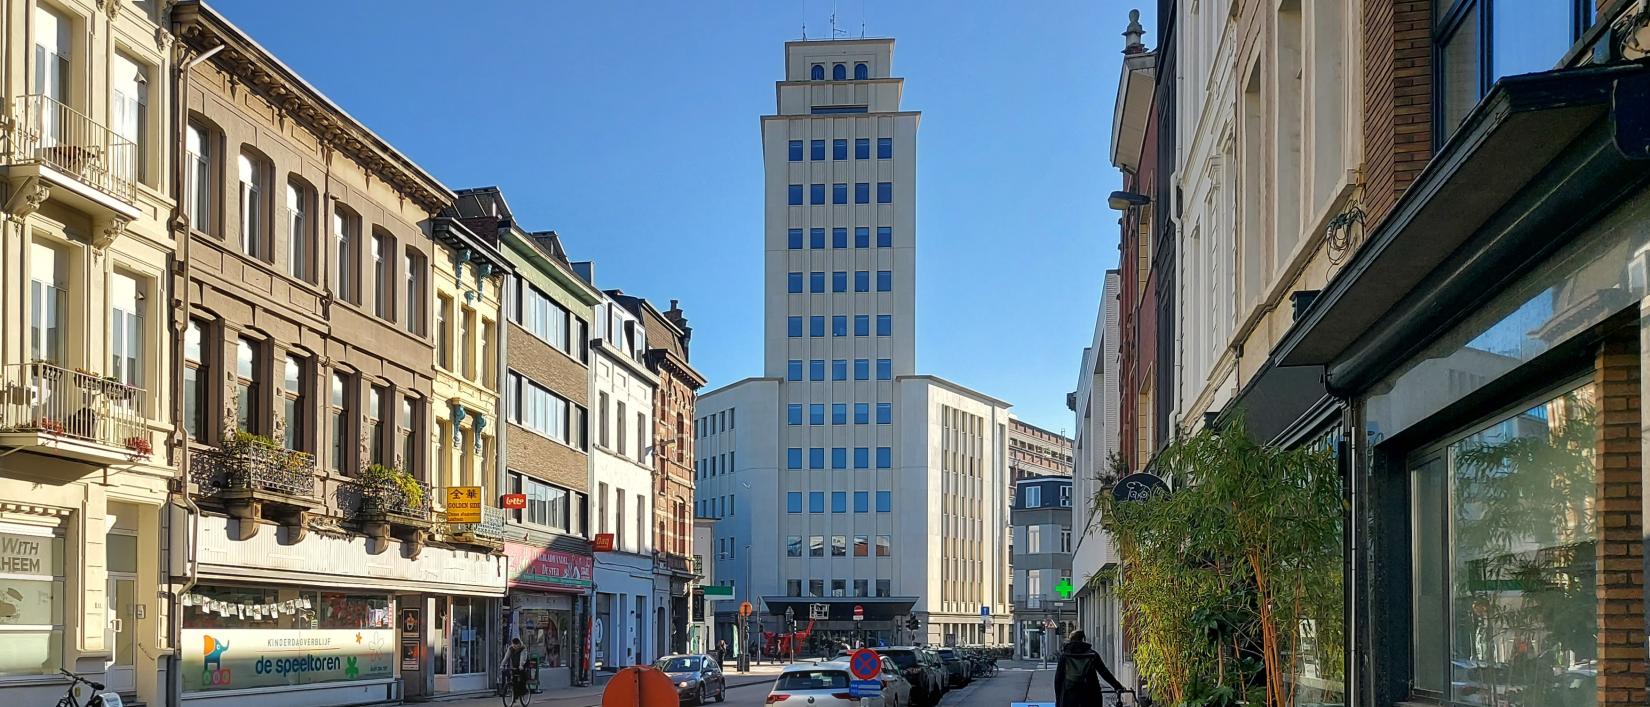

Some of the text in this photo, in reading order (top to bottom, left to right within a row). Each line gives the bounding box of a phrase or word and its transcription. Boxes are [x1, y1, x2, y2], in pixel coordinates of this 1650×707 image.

[267, 637, 332, 648] KINDERDAGVERBLIJF
[255, 653, 341, 677] de speeltoren
